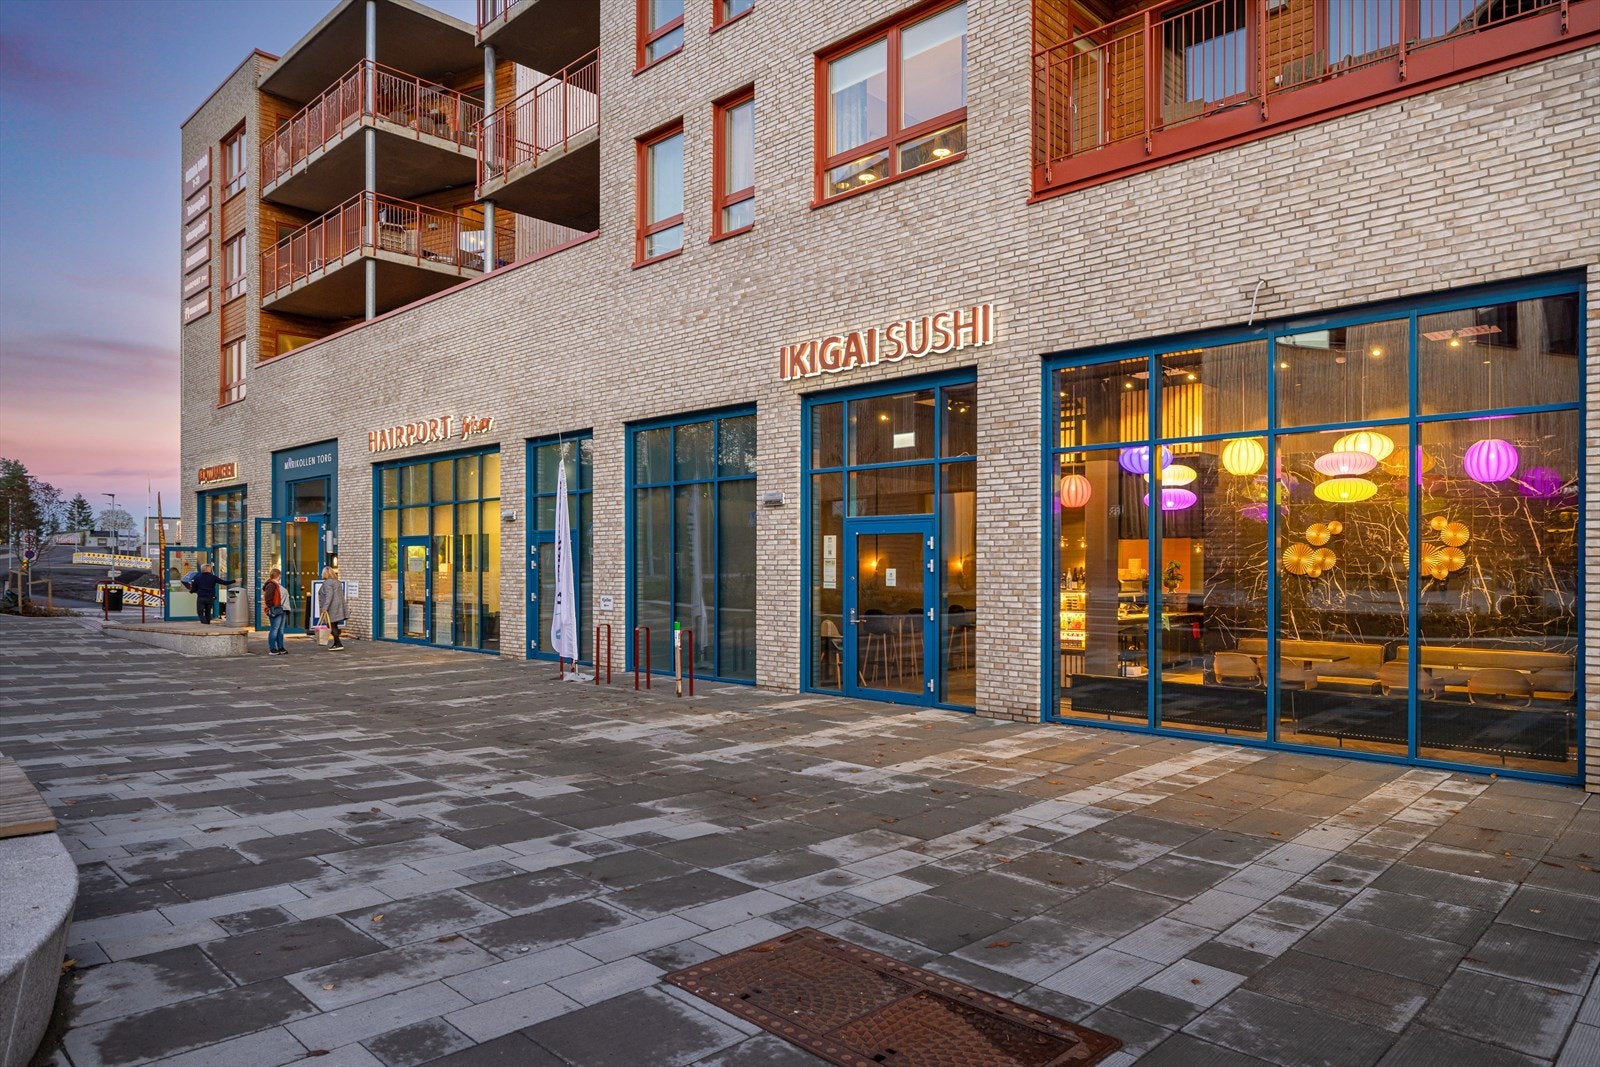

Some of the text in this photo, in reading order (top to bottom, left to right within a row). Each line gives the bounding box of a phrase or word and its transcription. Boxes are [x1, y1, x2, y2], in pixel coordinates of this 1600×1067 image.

[779, 304, 993, 381] IKIGAI SUSHI
[368, 415, 454, 452] HAIRPORT
[317, 453, 332, 464] TORG
